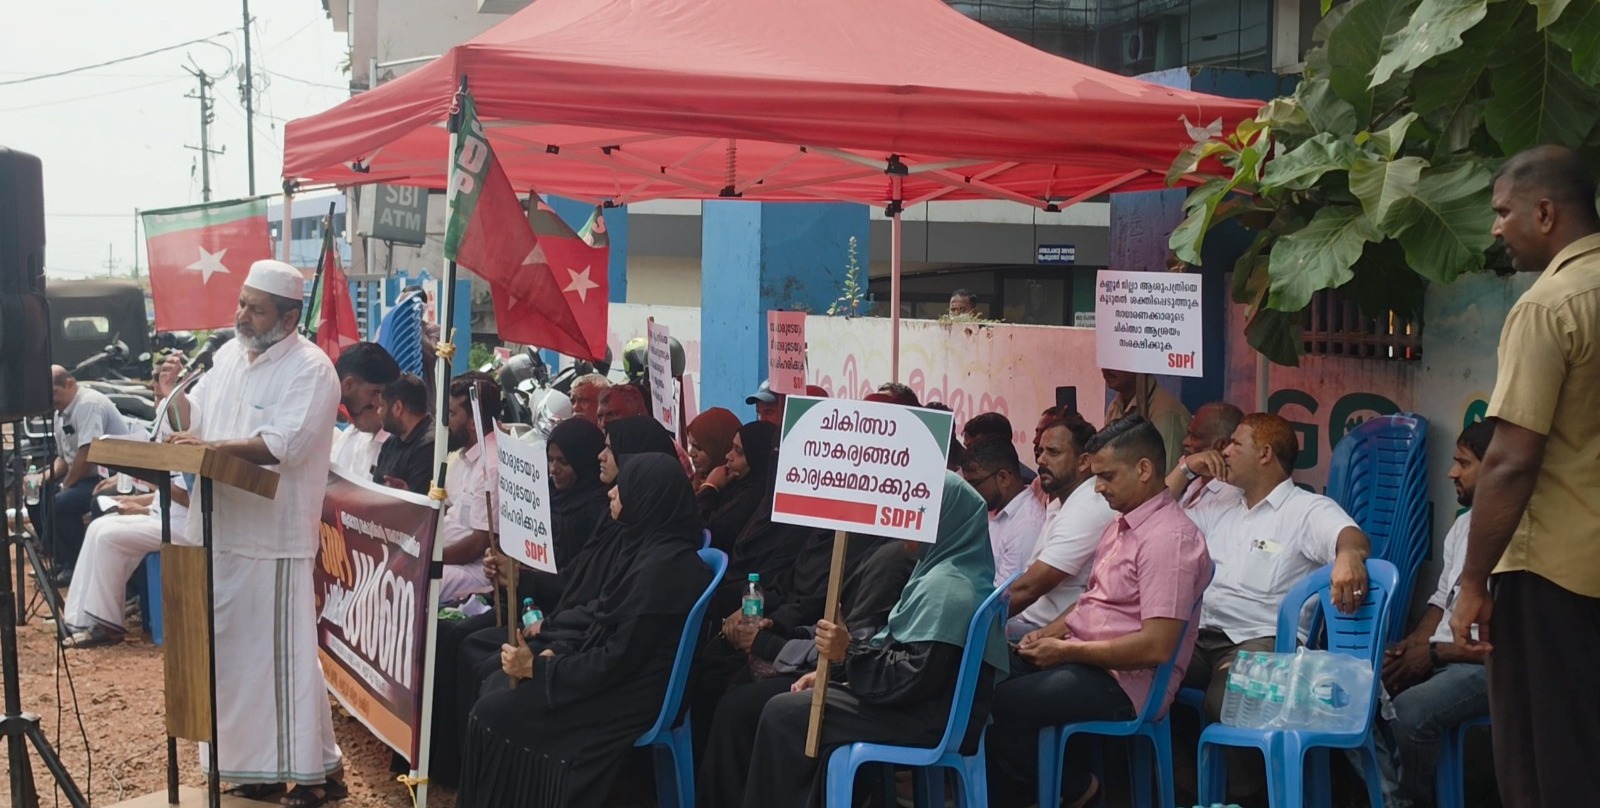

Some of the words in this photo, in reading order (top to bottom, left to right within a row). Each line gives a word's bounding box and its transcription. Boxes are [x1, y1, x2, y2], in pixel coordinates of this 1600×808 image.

[385, 184, 419, 208] SBI
[380, 207, 421, 232] ATM
[1168, 352, 1195, 369] SDPI
[820, 408, 897, 437] ചികിത്സാ
[803, 440, 910, 467] സൗകര്യങ്ങൾ
[785, 466, 931, 502] കാര്യക്ഷമമാക്കുക
[880, 505, 926, 531] SDPI
[524, 539, 549, 565] SDPI
